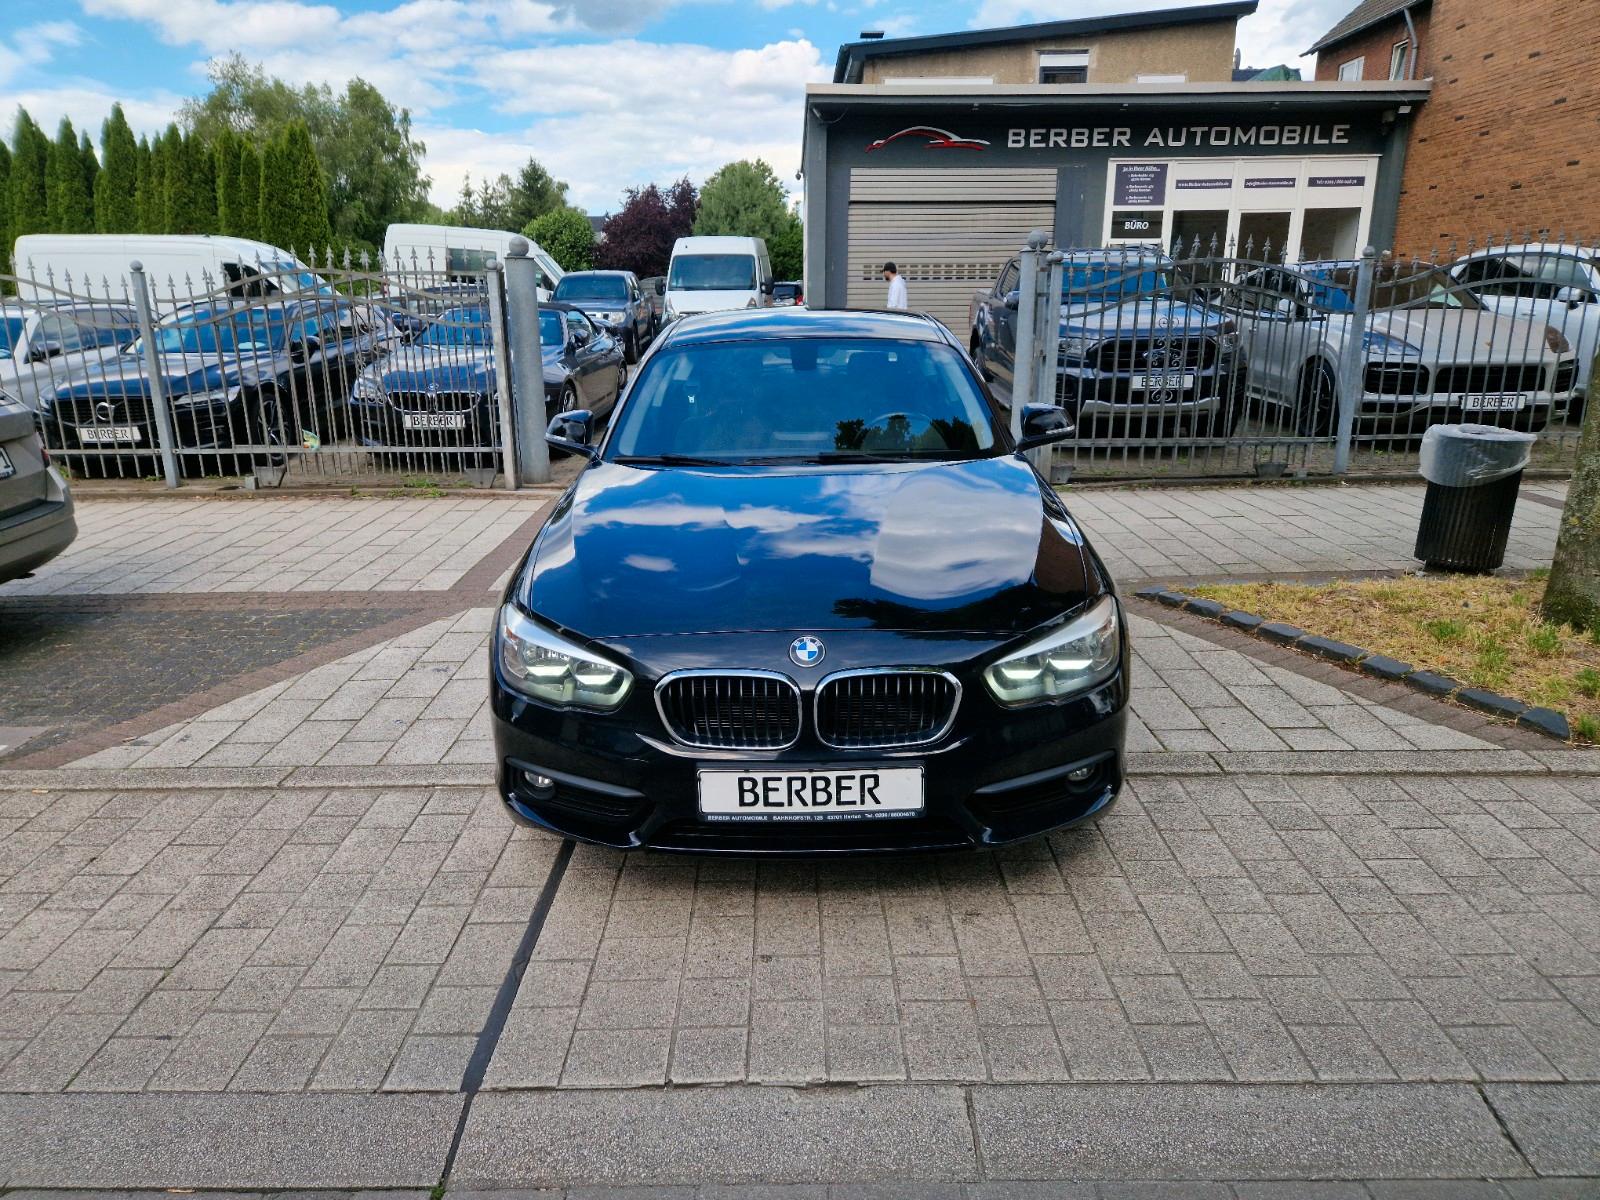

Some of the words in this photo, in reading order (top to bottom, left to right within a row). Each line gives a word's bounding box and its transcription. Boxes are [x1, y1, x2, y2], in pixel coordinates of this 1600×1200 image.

[1007, 127, 1131, 148] BERBER
[1144, 124, 1351, 147] AUTOMOBILE
[1124, 219, 1149, 230] BÜRO
[1141, 376, 1183, 388] BERER
[737, 773, 882, 807] BERBER
